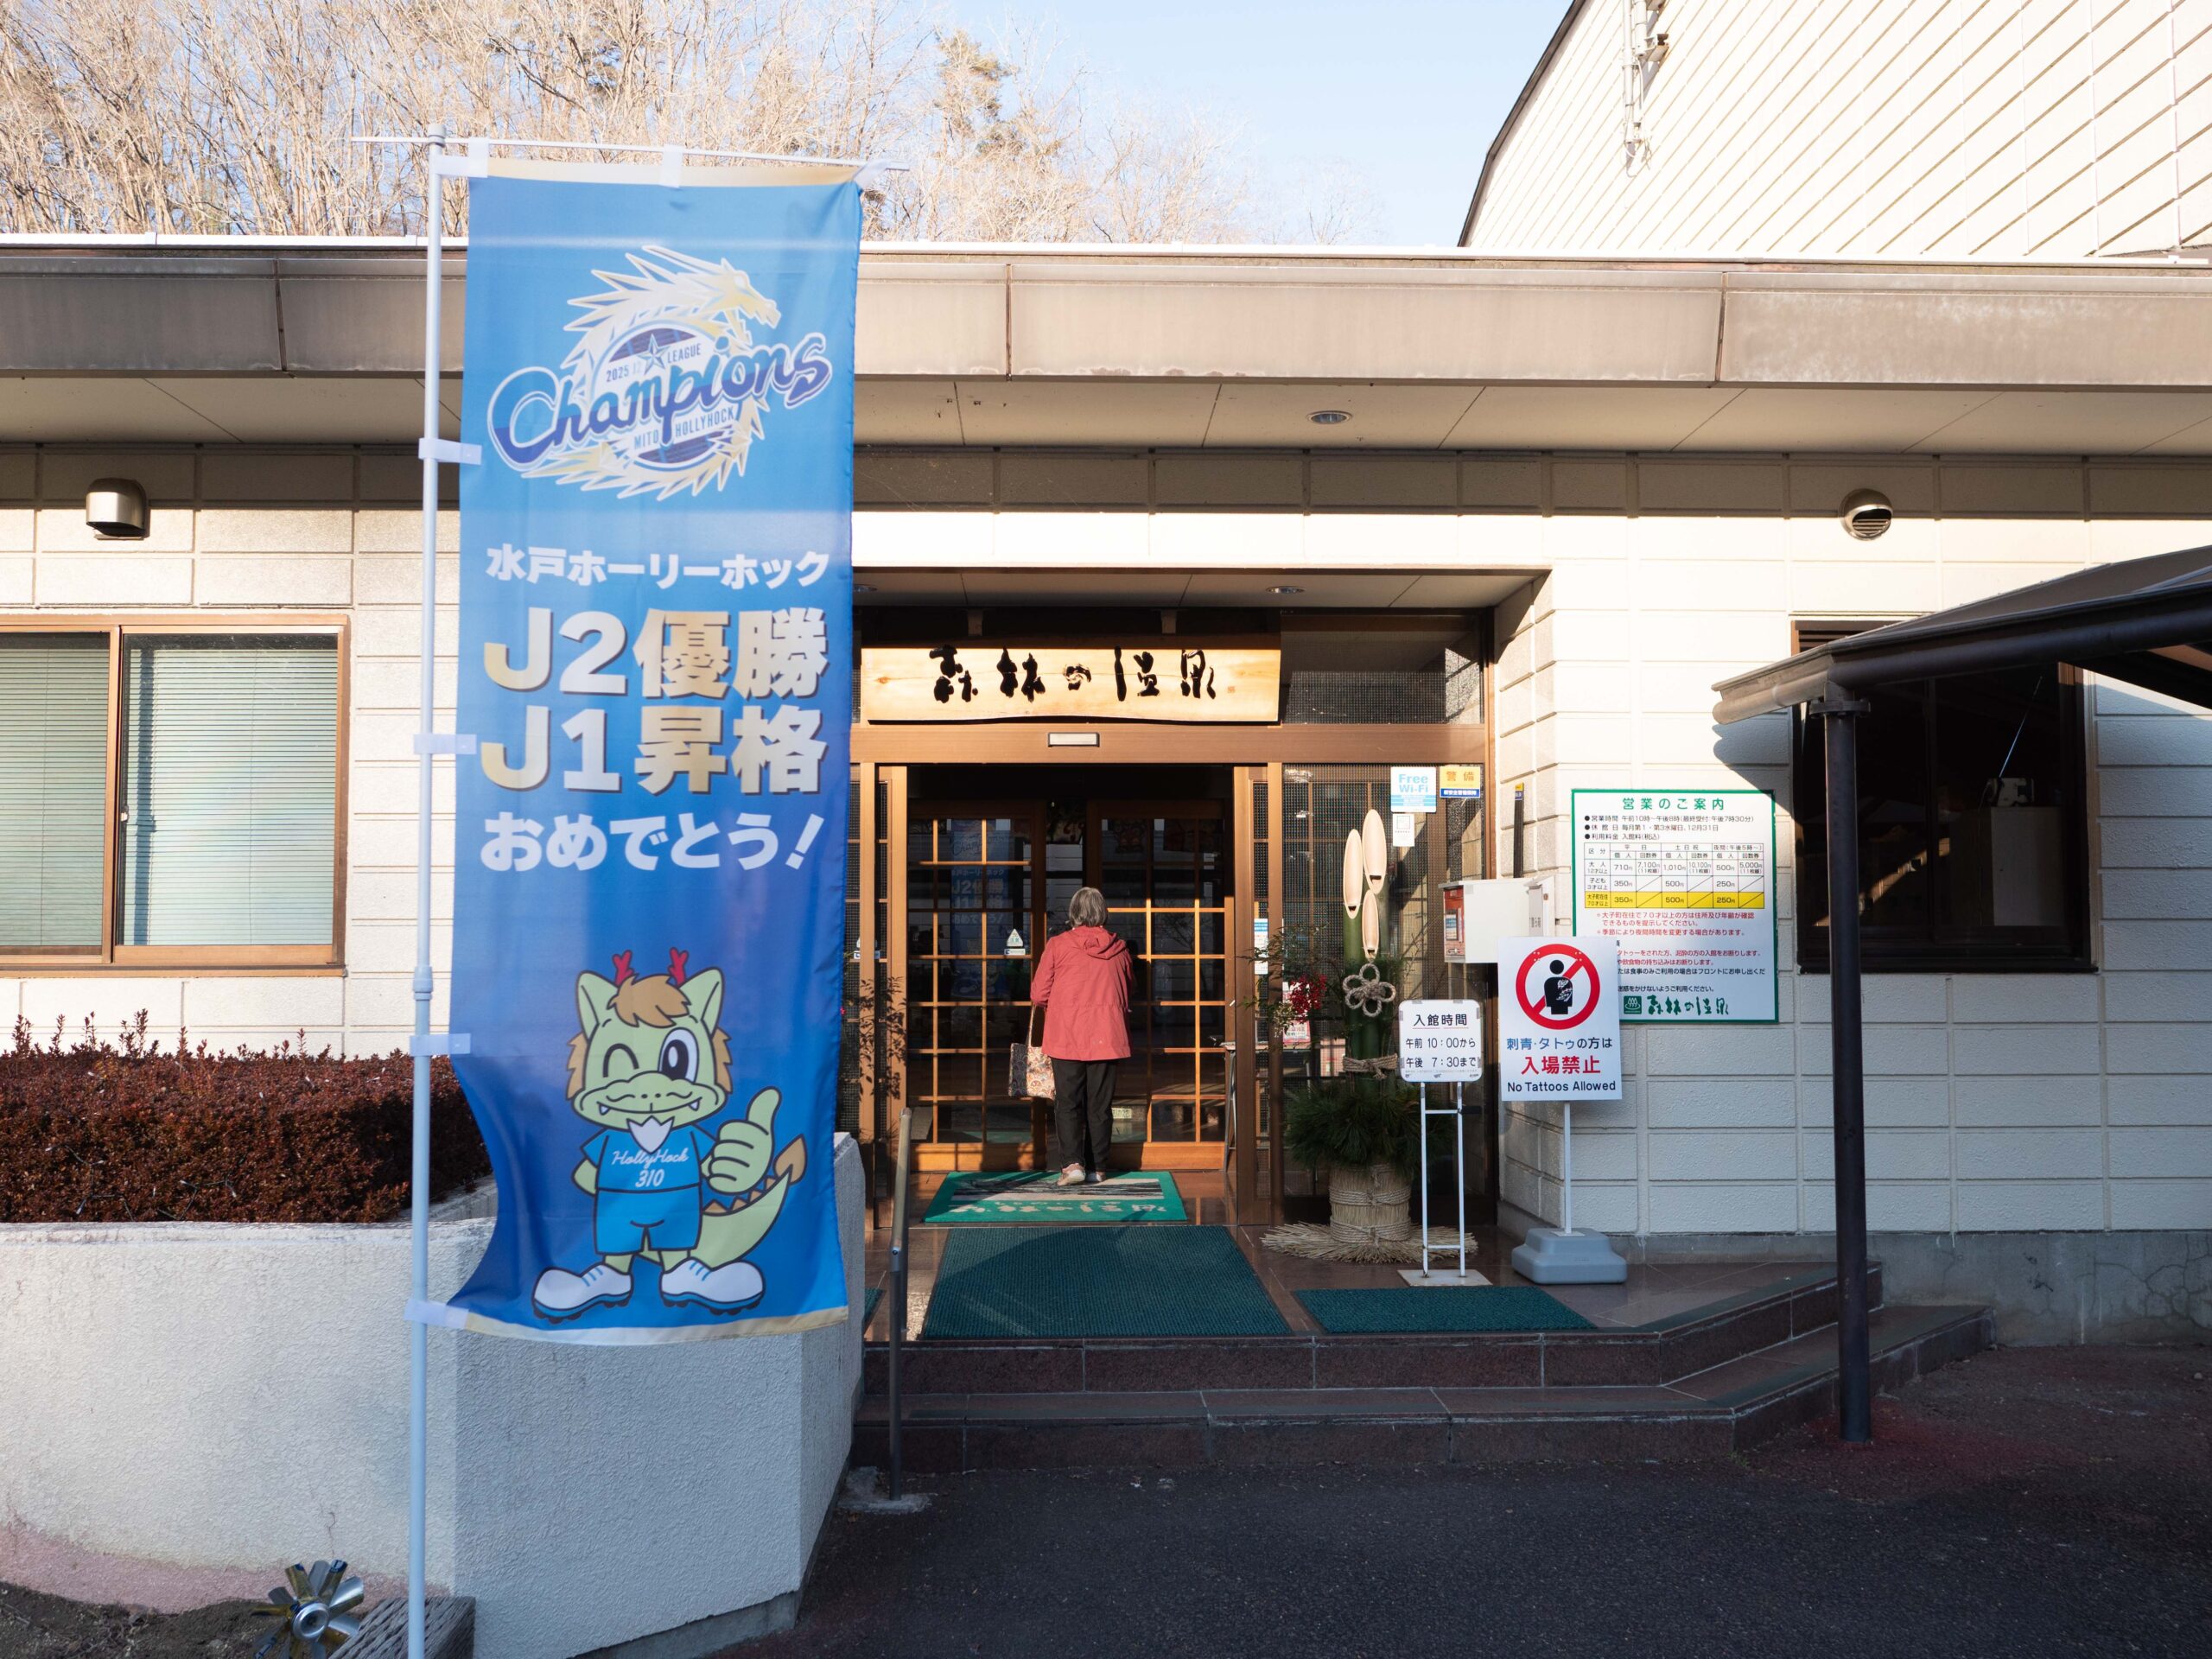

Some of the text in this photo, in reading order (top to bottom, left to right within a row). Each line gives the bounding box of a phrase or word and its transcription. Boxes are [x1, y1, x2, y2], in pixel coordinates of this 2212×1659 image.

[607, 365, 629, 382] 2025
[667, 343, 702, 364] LEAGUE
[488, 334, 832, 469] Champions
[633, 406, 734, 449] MITO HOLLYHOCK
[486, 543, 830, 589] 水戸ホーリーホック
[484, 607, 830, 700] J2優勝
[480, 704, 828, 795] J1昇格
[1398, 773, 1429, 784] Free
[1399, 785, 1429, 793] Wi-Fi
[1622, 798, 1725, 810] 営業のご案内
[1414, 1014, 1467, 1027] 入館時間
[1405, 1038, 1423, 1049] 午前
[1406, 1057, 1423, 1068] 午後
[1521, 1055, 1601, 1075] 入場禁止
[1507, 1080, 1617, 1092] No Tattoos Allowed
[635, 1168, 664, 1188] 310
